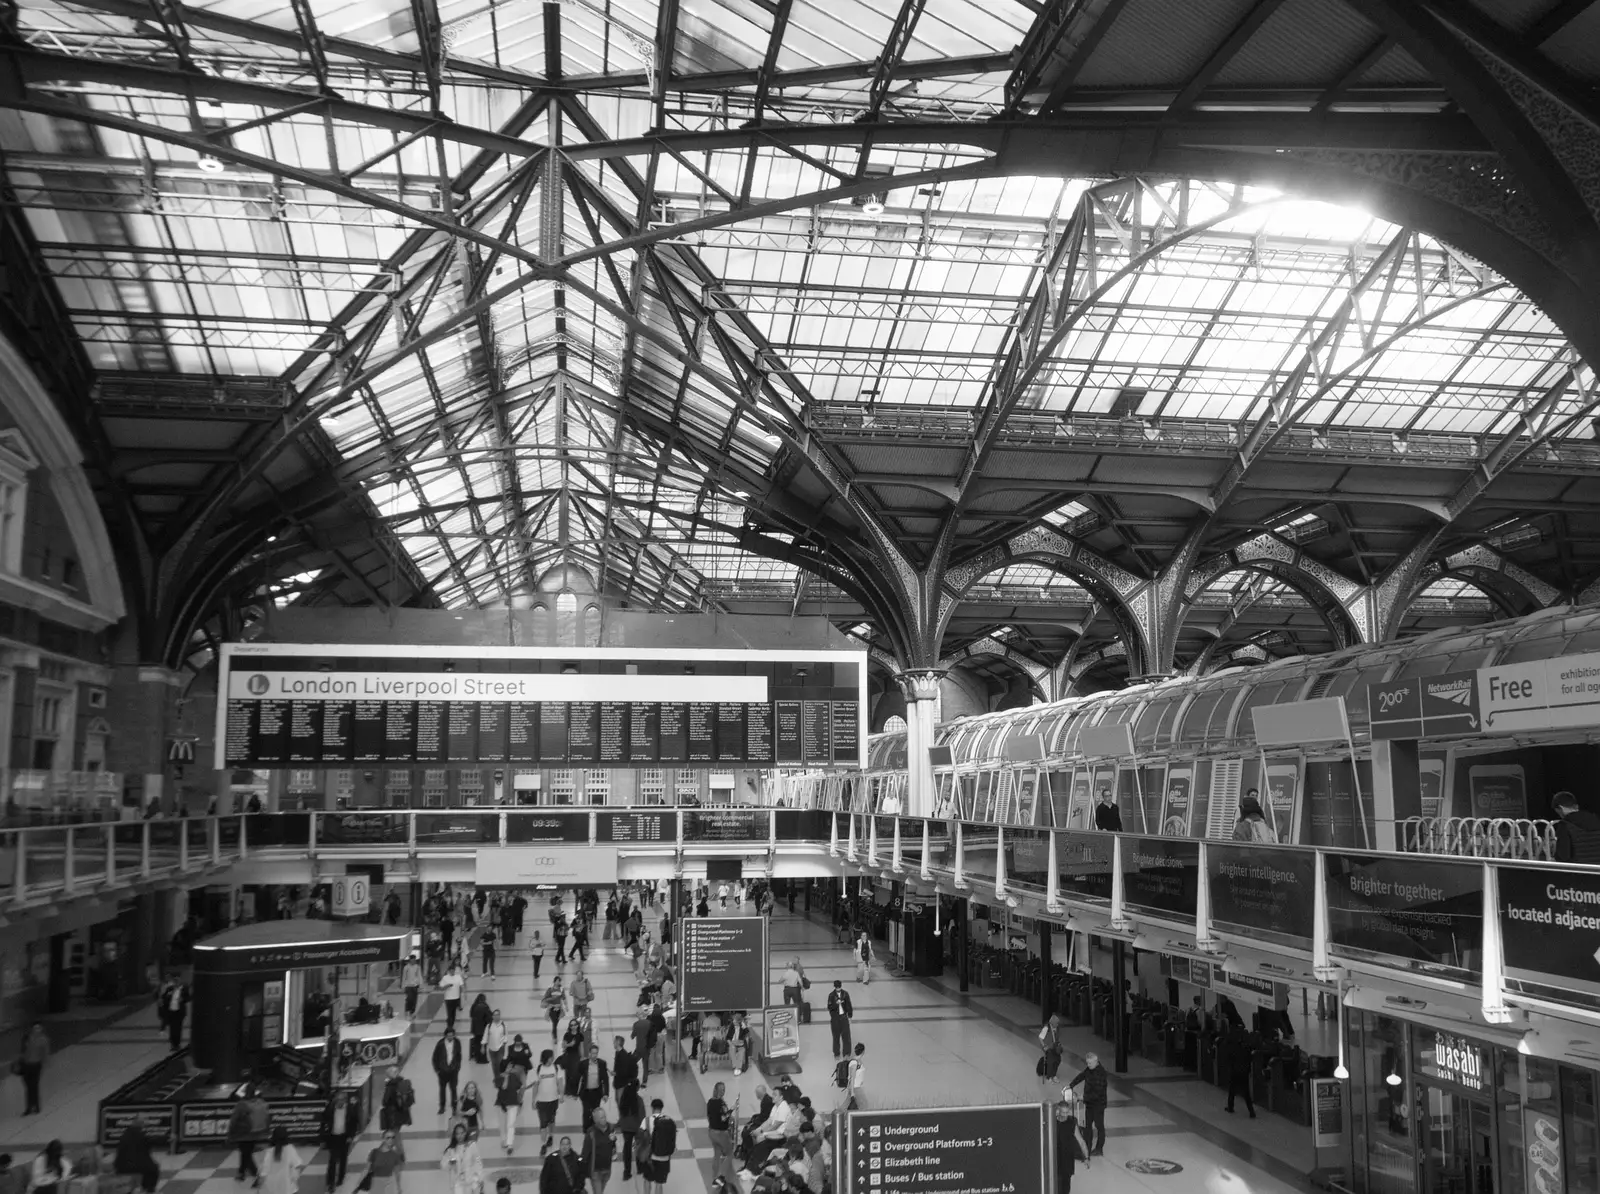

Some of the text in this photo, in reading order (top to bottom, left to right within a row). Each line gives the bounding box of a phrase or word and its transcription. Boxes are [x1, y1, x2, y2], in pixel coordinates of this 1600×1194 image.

[281, 676, 526, 697] London Liverpool Street
[1489, 676, 1532, 701] Free
[1561, 682, 1600, 694] for all ag
[1132, 852, 1155, 867] Brighter
[1219, 862, 1298, 884] Brighter intelligence.
[1350, 876, 1446, 902] Brighter together.
[894, 897, 901, 907] 8
[1508, 903, 1552, 924] located
[1436, 1043, 1480, 1077] wasabi
[884, 1124, 939, 1137] Underground
[884, 1140, 934, 1153] Overground
[935, 1138, 976, 1149] Platforms
[884, 1156, 940, 1168] Elizabeth line
[885, 1170, 965, 1184] Buses / Bus station
